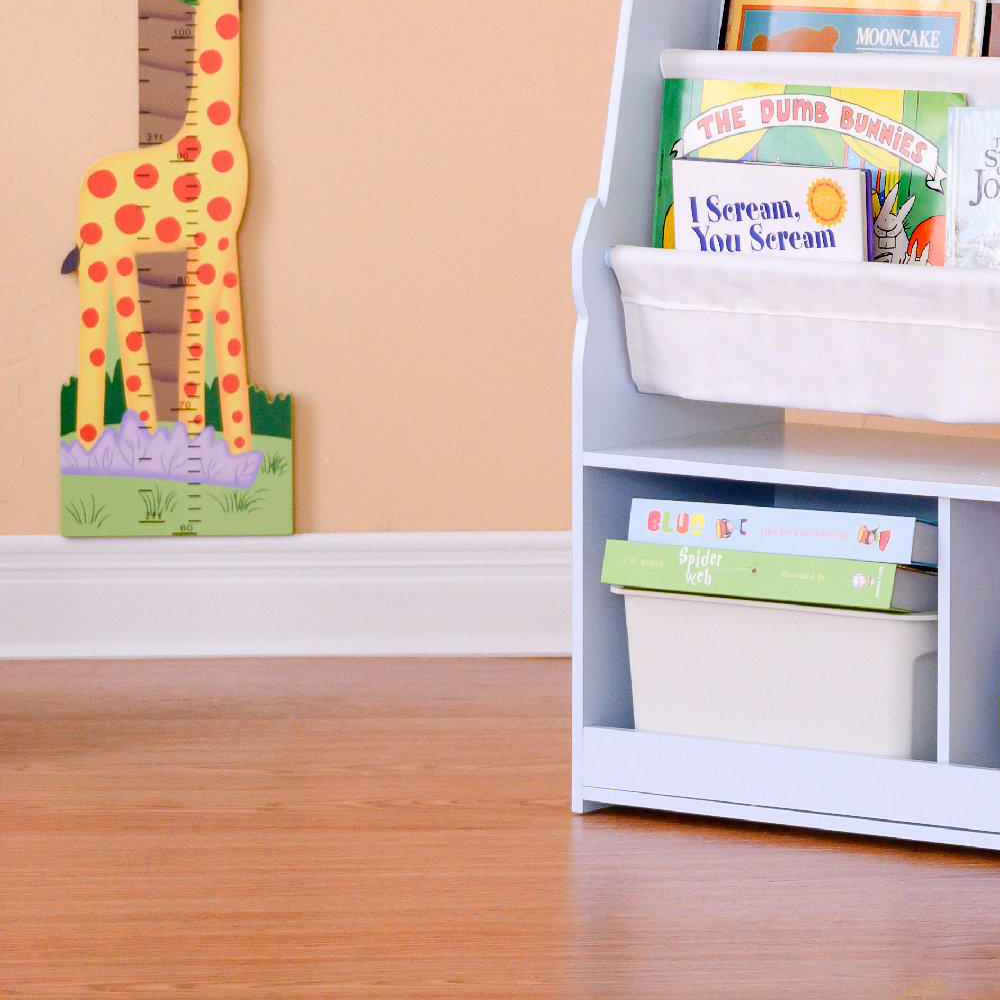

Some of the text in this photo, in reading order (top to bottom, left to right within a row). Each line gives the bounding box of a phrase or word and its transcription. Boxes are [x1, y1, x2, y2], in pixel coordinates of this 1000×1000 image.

[172, 28, 192, 36] 100
[856, 26, 940, 49] MOONCAKE
[696, 98, 930, 163] THE DUMB BUNNIES
[688, 195, 701, 224] I
[706, 194, 801, 223] Scream,
[690, 223, 836, 252] You Scream
[679, 546, 723, 573] Spider
[685, 567, 712, 586] web
